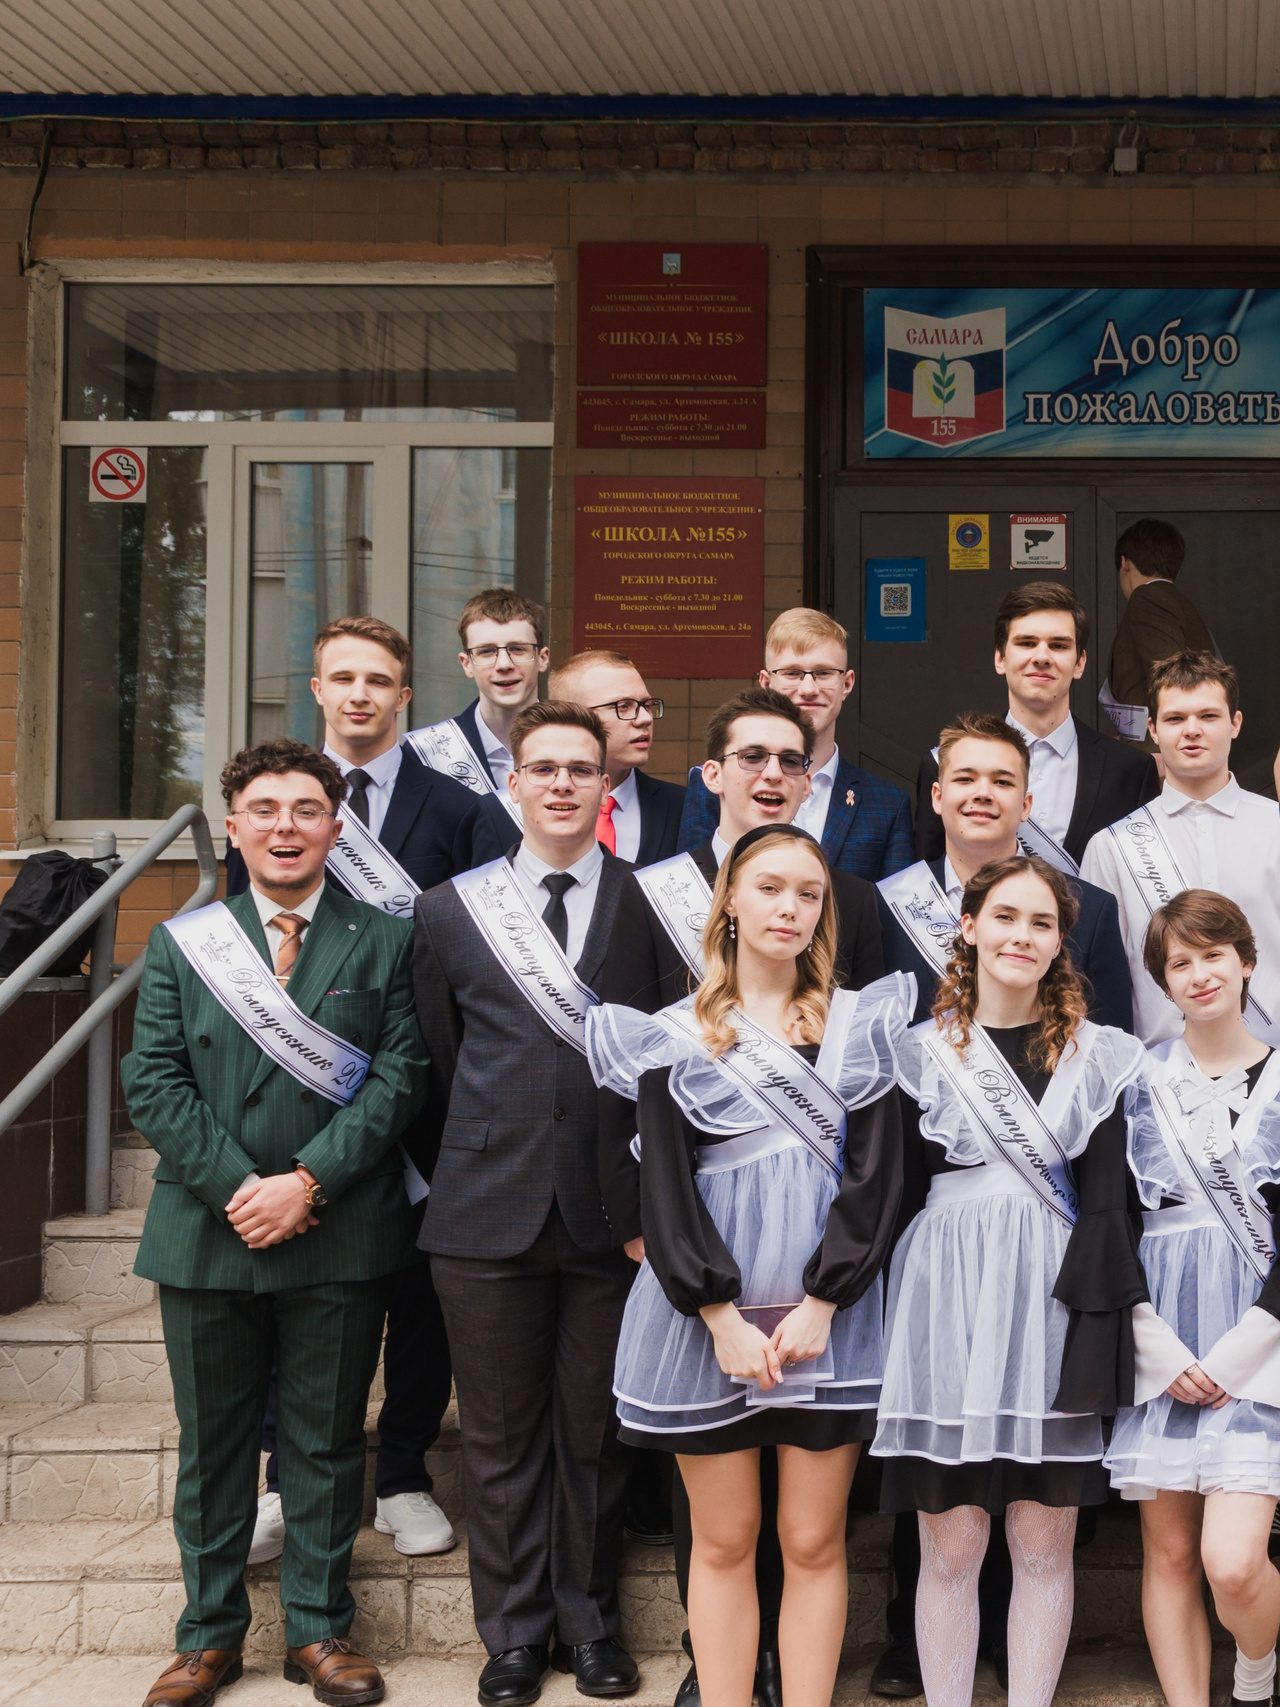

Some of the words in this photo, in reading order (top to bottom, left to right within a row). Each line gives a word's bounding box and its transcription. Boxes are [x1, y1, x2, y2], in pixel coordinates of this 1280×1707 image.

[606, 294, 681, 302] МУНИЦИПАЛЬНОЕ
[684, 294, 739, 302] БЮДЖЕТНОЕ
[590, 305, 693, 313] ОБЩЕОБРАЗОВАТЕЛЬНОЕ
[597, 331, 679, 345] «ШКОЛА
[708, 332, 745, 346] 155»
[905, 327, 985, 346] САМАРА
[1093, 318, 1239, 380] Добро
[611, 373, 668, 381] ГОРОДСКОГО
[670, 373, 702, 381] ОКРУГА
[594, 424, 649, 432] Понедельник
[656, 423, 688, 432] суббота
[726, 423, 747, 431] 21.00
[930, 419, 957, 436] 155
[620, 434, 672, 442] Воскресенье
[598, 492, 681, 500] МУНИЦИПАЛЬНОЕ
[695, 506, 756, 514] УЧРЕЖДЕНИЕ
[1017, 516, 1059, 524] ВНИМАНИЕ
[591, 527, 681, 542] «ШКОЛА
[686, 527, 748, 542] №155»
[603, 552, 662, 560] ГОРОДСКОГО
[663, 552, 697, 560] ОКРУГА
[699, 552, 735, 560] САМАРА
[621, 576, 664, 584] РЕЖИМ
[667, 576, 718, 584] РАБОТЫ:
[655, 593, 686, 602] суббота
[620, 604, 671, 612] Воскресенье
[677, 603, 717, 611] выходной
[584, 623, 614, 631] 443045,
[623, 623, 657, 632] Самара,
[658, 624, 670, 632] ул.
[672, 623, 727, 632] Артемовская,
[738, 623, 751, 631] 24а
[500, 911, 586, 1025] Выпускник
[226, 968, 333, 1071] Выпускник
[734, 1028, 842, 1148] Выпускница
[973, 1069, 1067, 1201] Выпускница
